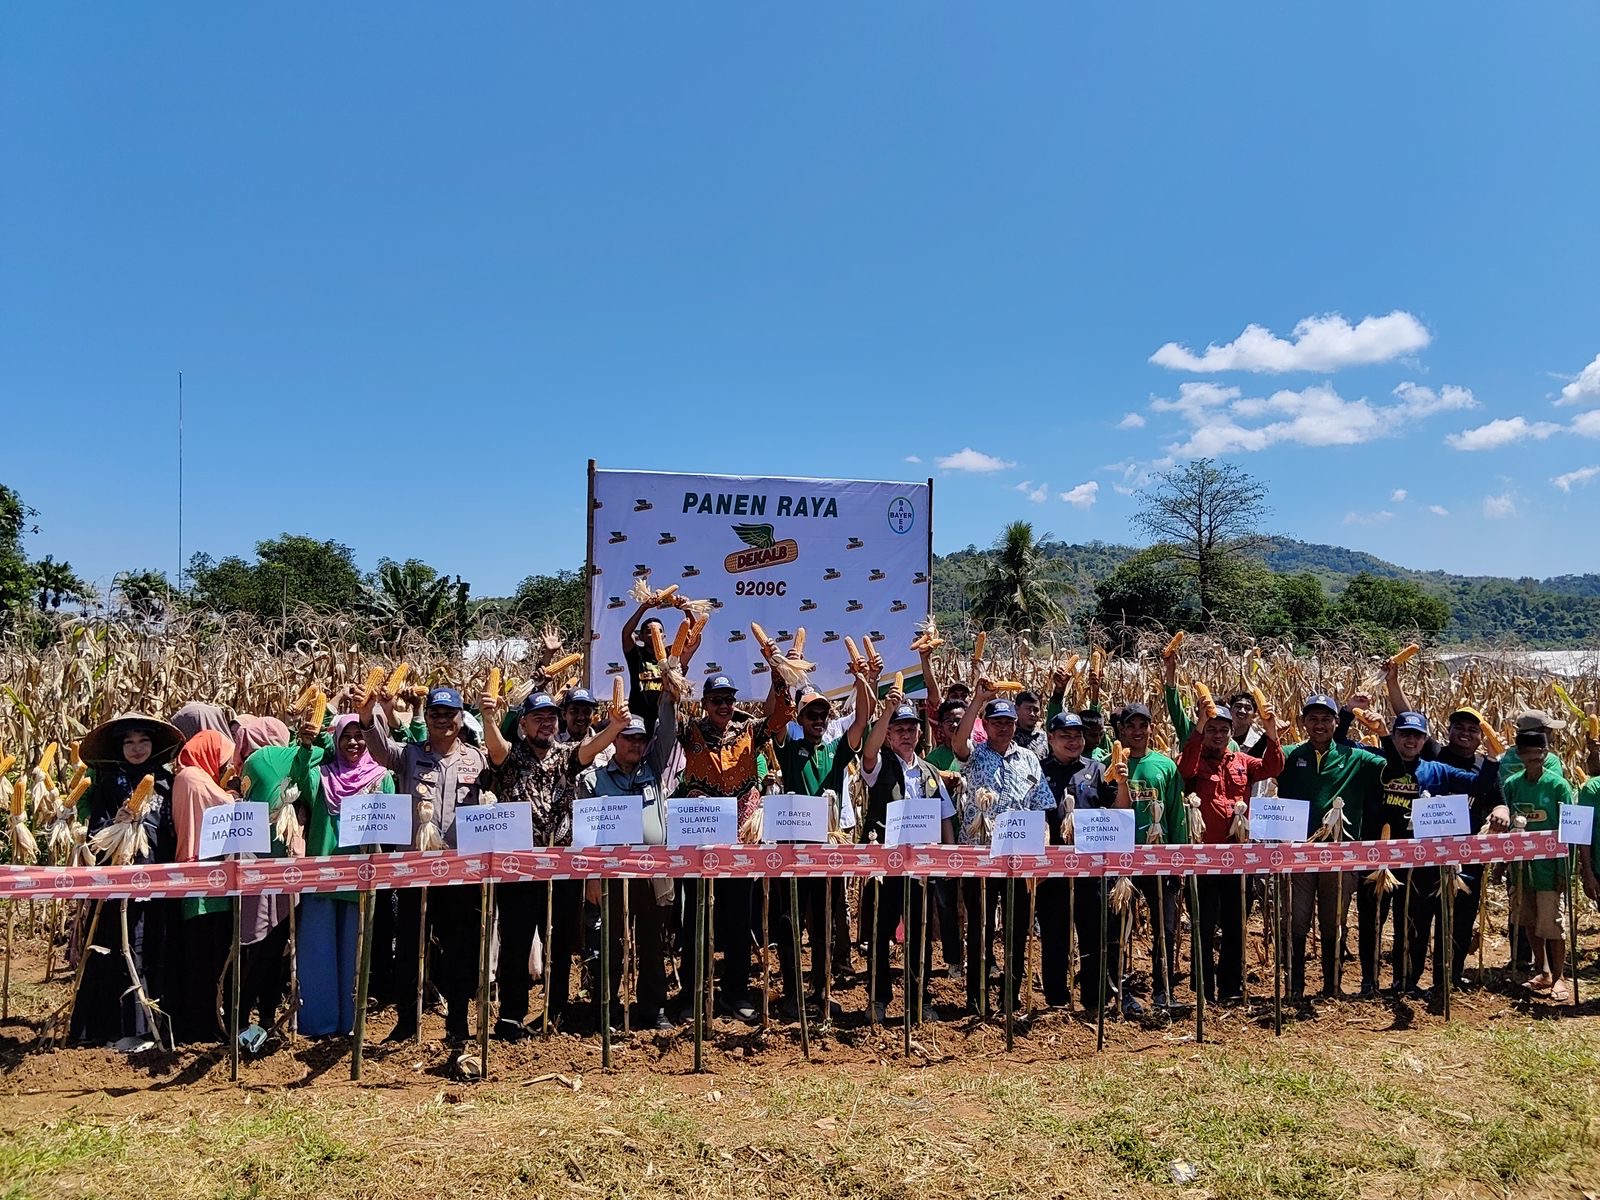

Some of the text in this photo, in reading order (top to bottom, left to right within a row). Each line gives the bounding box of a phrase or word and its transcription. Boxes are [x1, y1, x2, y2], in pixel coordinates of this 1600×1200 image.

[682, 492, 838, 518] PANEN RAYA
[736, 545, 788, 570] DEKALB
[735, 580, 787, 597] 9209C
[361, 802, 387, 810] KADIS
[579, 804, 628, 814] KEPALA BRMP
[677, 805, 721, 814] GUBERNUR
[1263, 804, 1285, 812] CAMAT
[211, 811, 254, 825] DANDIM
[350, 813, 396, 822] PERTANIAN
[465, 810, 516, 823] KAPOLRES
[586, 814, 621, 823] SEREALIA
[679, 816, 719, 824] SULAWESI
[1255, 813, 1295, 822] TOMPOBULU
[357, 823, 388, 832] MAROS
[474, 822, 508, 833] MAROS
[590, 823, 616, 831] MAROS
[775, 819, 812, 827] INDONESIA
[211, 827, 253, 841] MAROS
[998, 831, 1026, 840] MAROS
[1085, 834, 1116, 842] PROVINSI
